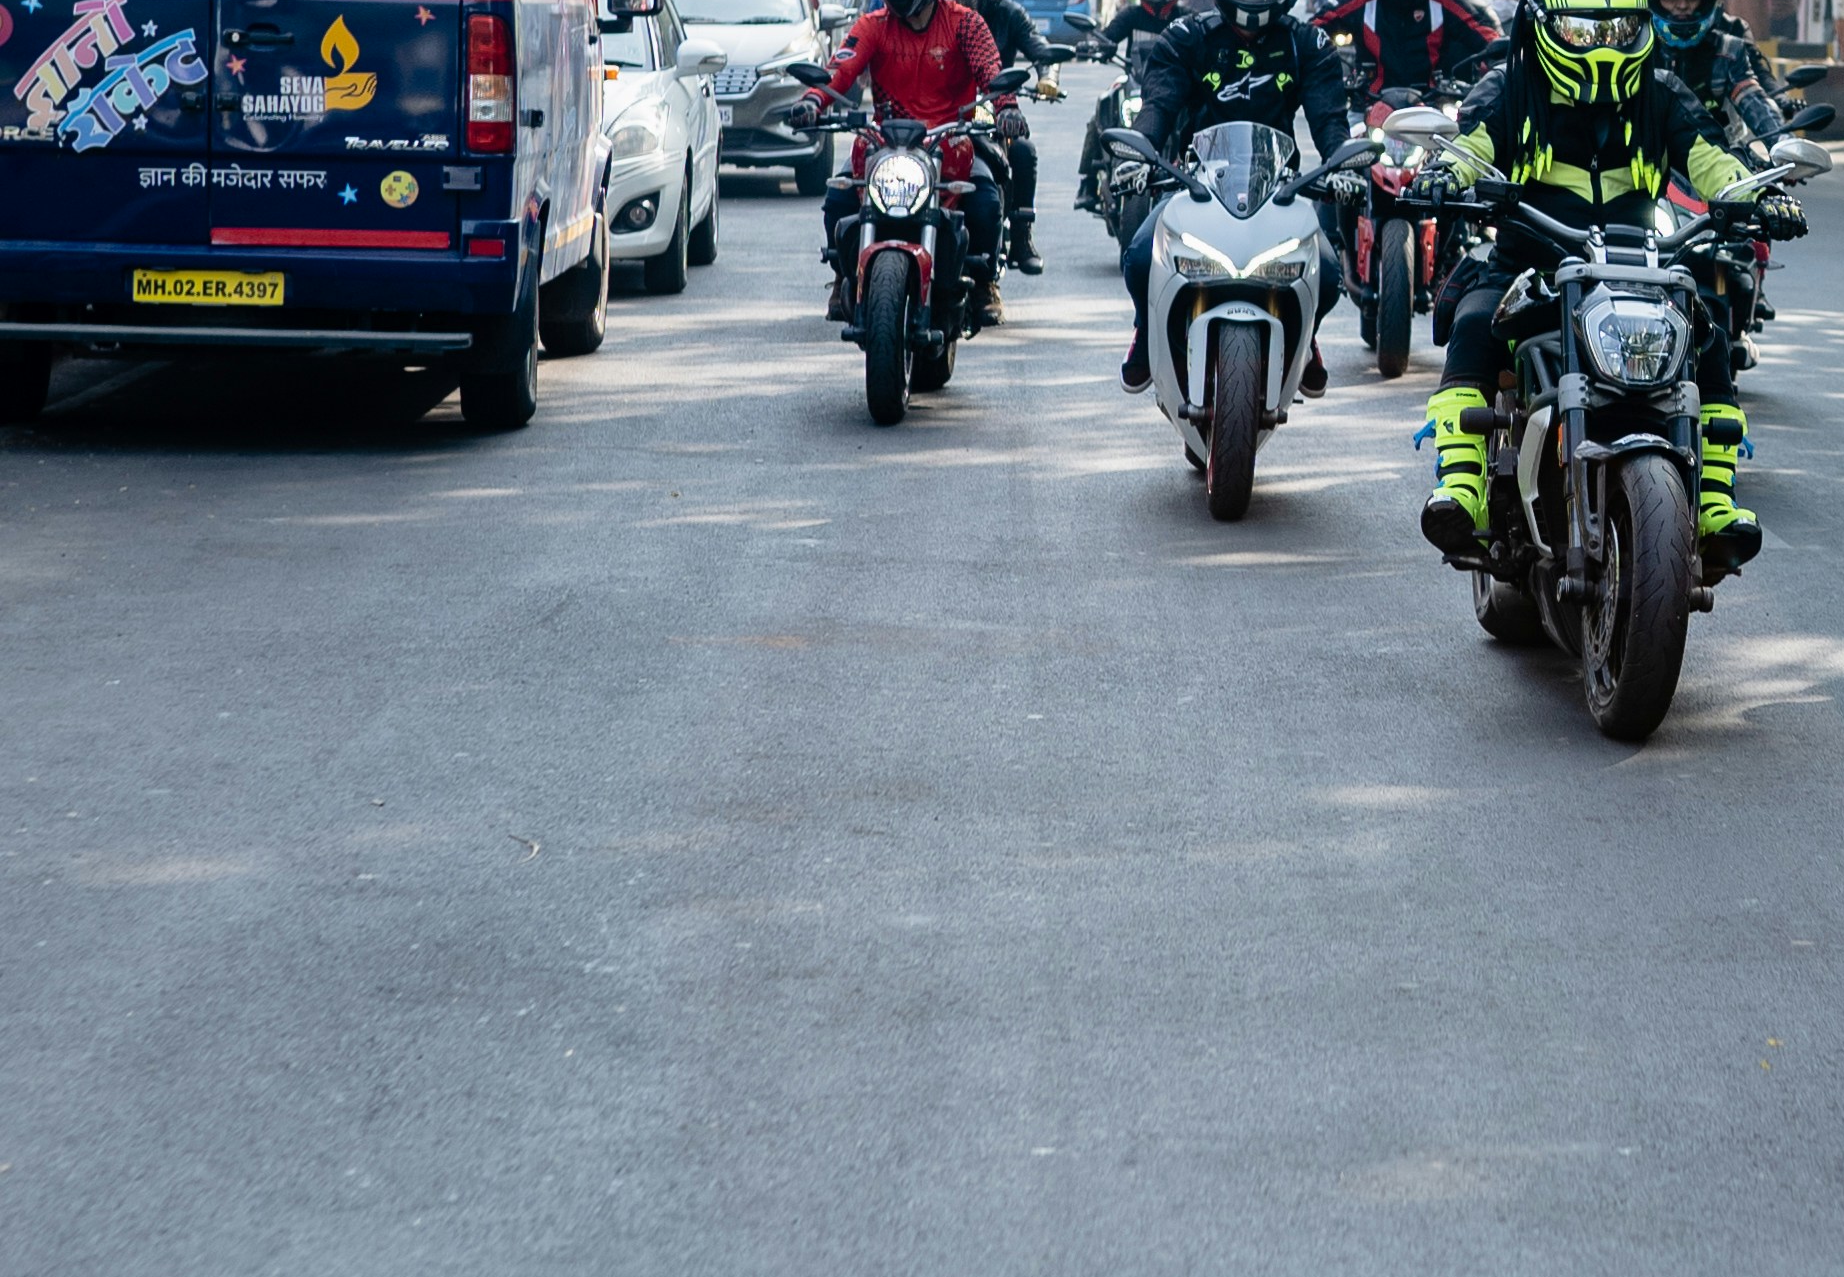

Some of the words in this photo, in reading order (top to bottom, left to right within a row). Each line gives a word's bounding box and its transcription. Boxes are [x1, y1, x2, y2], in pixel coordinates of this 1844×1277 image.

[280, 76, 324, 94] SEVA
[242, 94, 324, 113] SAHAYOG
[345, 136, 449, 151] TRAVELLER
[138, 167, 177, 188] ज्ञान
[181, 162, 207, 187] की
[211, 163, 273, 189] मजेदार
[277, 170, 326, 189] सफर
[137, 279, 279, 299] MH.02.ER.4397
